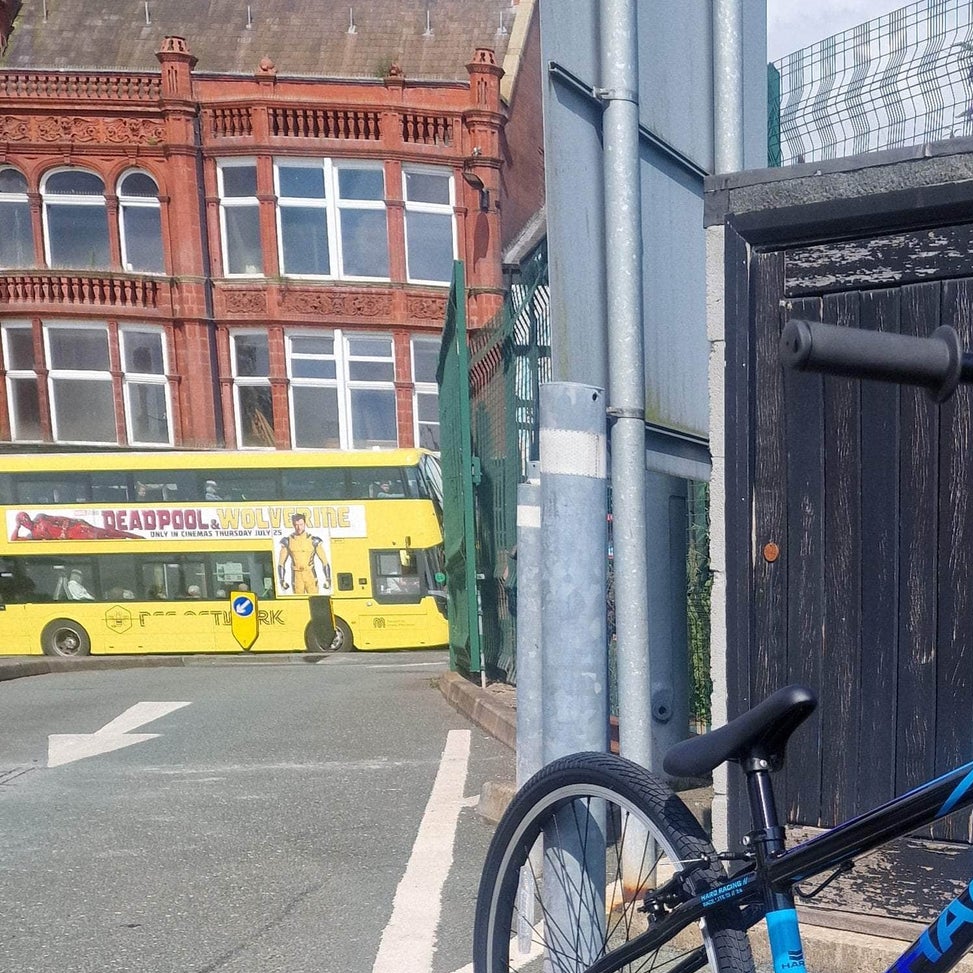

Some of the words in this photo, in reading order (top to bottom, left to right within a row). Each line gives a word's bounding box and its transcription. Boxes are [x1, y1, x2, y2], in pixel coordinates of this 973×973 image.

[101, 509, 209, 531] DEADPOOL
[718, 880, 742, 894] RACING
[781, 960, 805, 969] HAR
